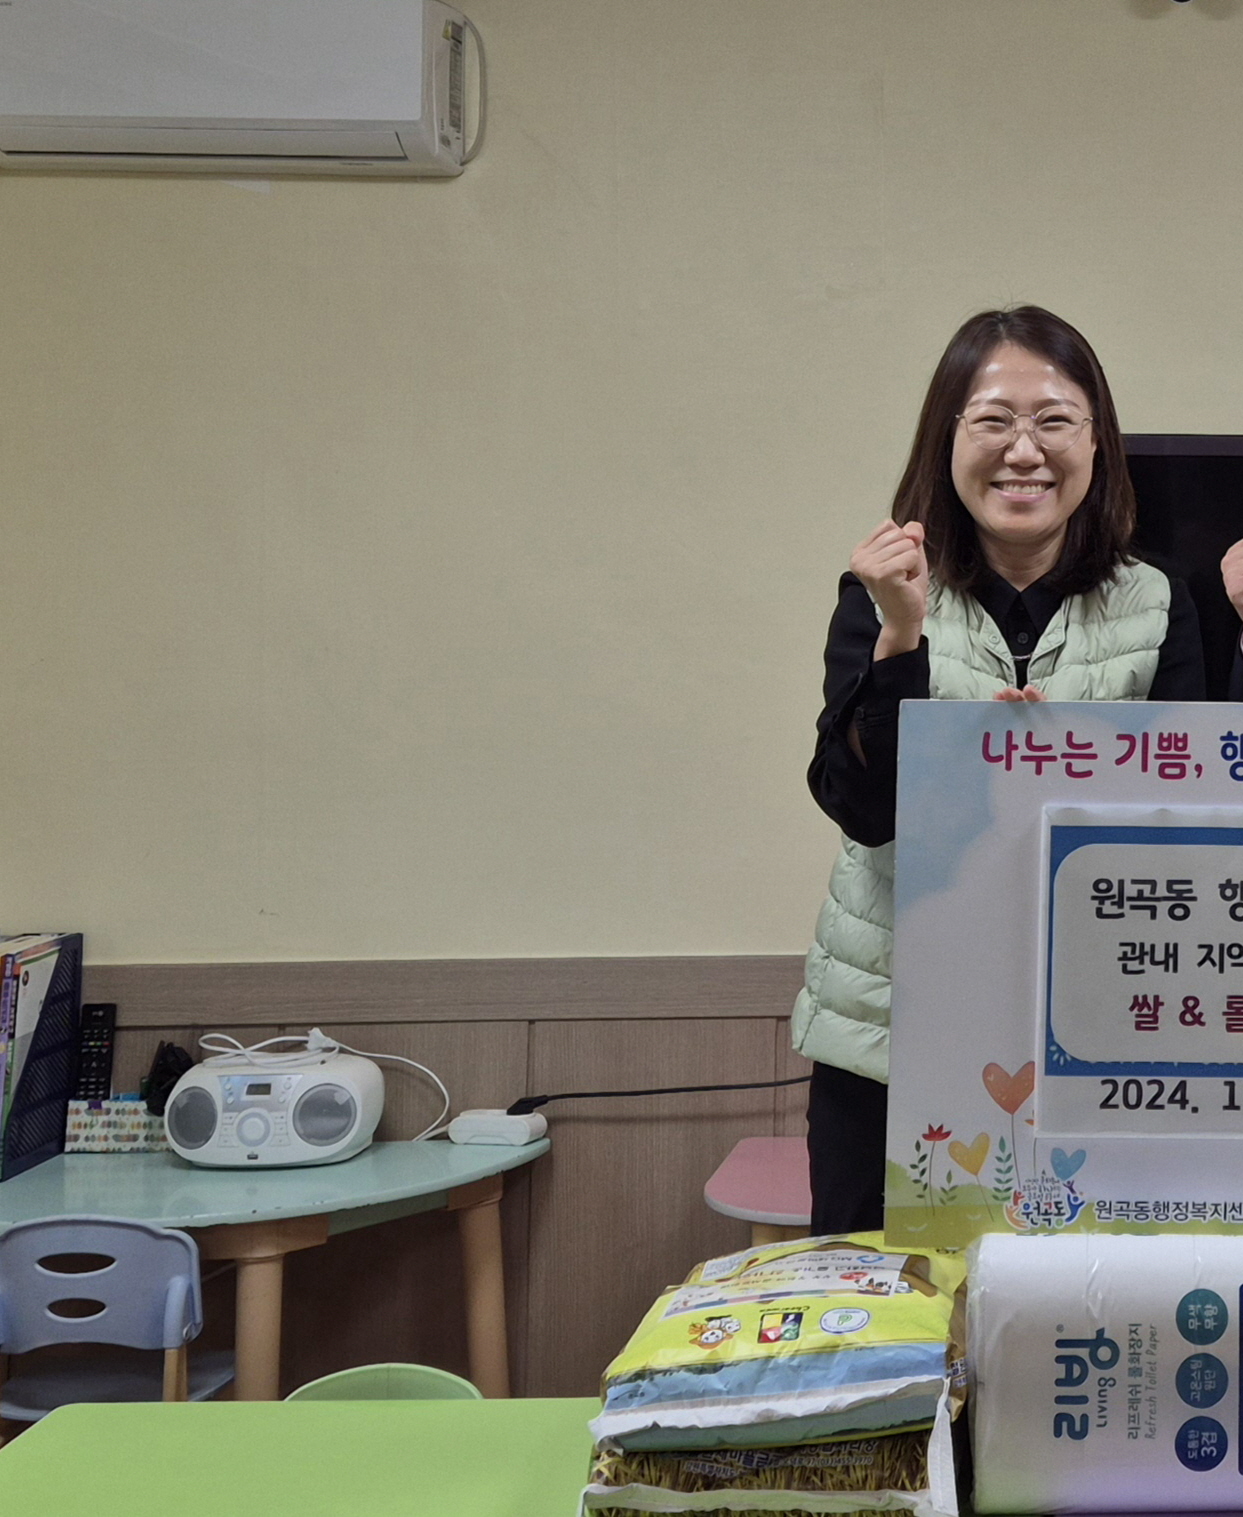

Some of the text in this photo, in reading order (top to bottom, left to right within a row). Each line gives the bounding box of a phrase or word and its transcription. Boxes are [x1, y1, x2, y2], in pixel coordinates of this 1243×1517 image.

[981, 730, 1098, 780] 나누는
[1114, 731, 1203, 780] 기쁨,
[1090, 877, 1197, 922] 원곡동
[1116, 942, 1179, 976] 관내
[1129, 995, 1163, 1031] 쌀
[1179, 996, 1205, 1028] &
[1099, 1079, 1199, 1113] 2024.
[1021, 1201, 1066, 1226] 원곡동
[1188, 1305, 1201, 1330] 무색
[1205, 1304, 1218, 1330] 무향
[1053, 1327, 1120, 1440] 리빙
[1128, 1323, 1142, 1440] 리프레쉬 롤화장지
[1145, 1324, 1159, 1439] Refresh Toilet Paper
[1190, 1360, 1201, 1401] 고온스팀
[1205, 1370, 1216, 1391] 원단
[1188, 1429, 1199, 1459] 도톰한
[1200, 1431, 1218, 1457] 3겹
